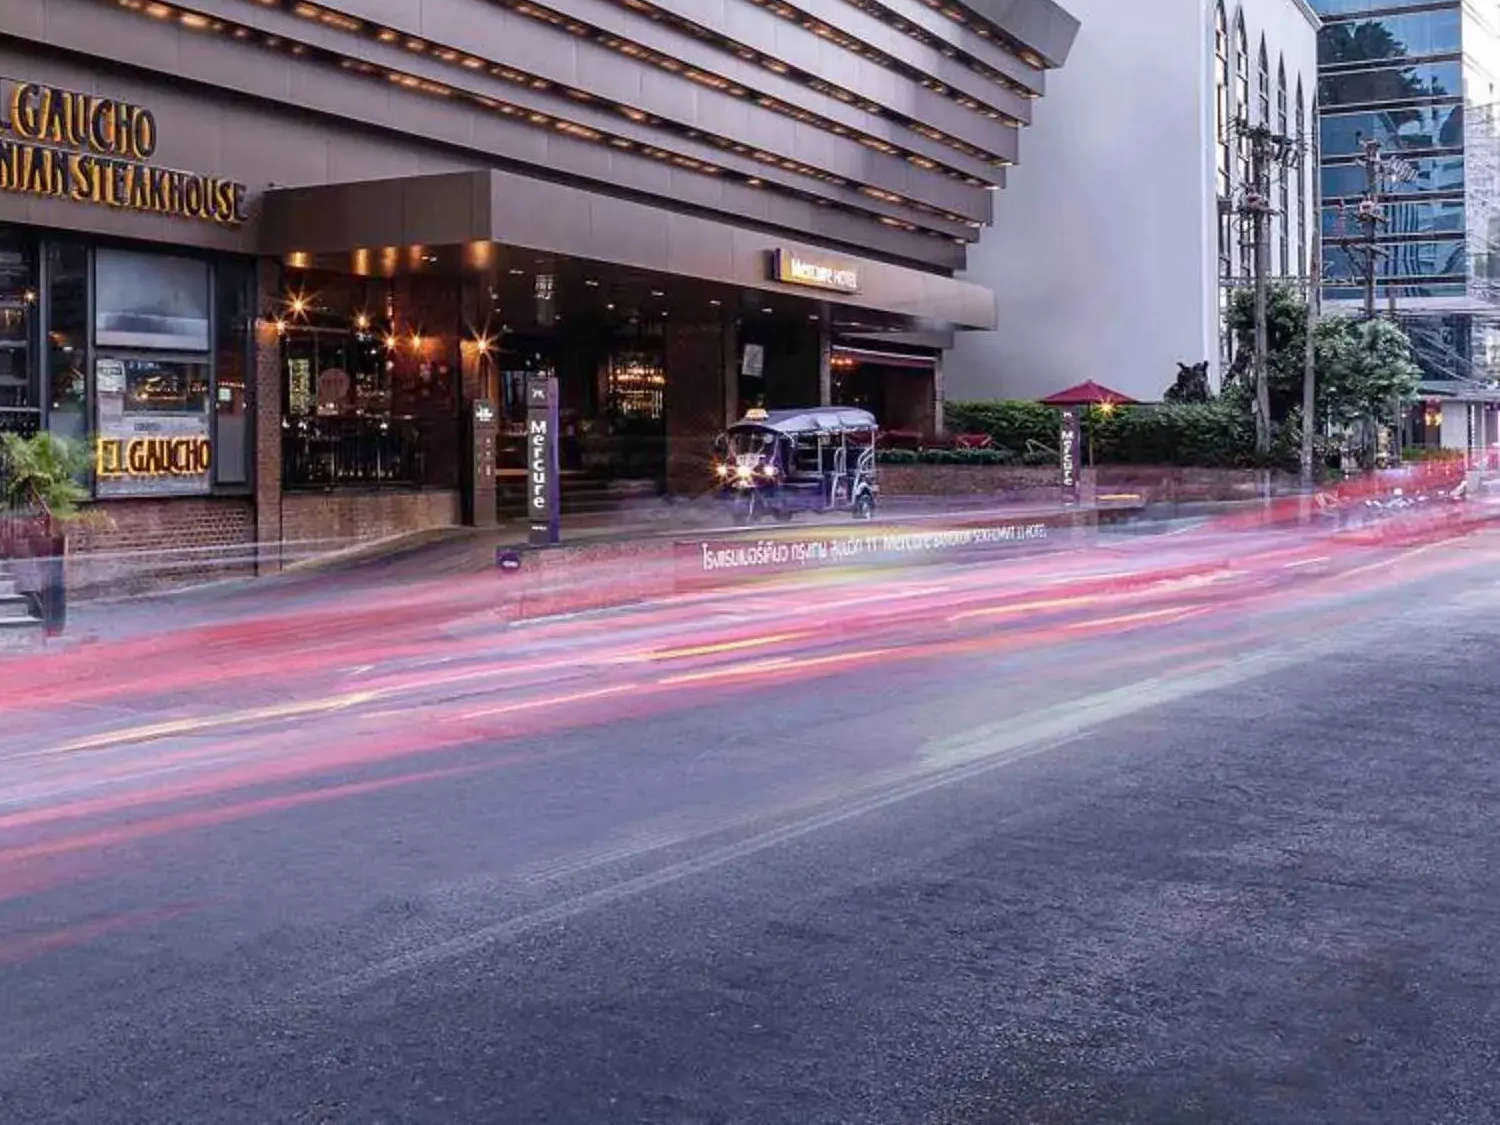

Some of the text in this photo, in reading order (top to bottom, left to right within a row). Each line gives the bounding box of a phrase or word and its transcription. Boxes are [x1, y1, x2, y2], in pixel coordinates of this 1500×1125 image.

[10, 81, 157, 160] GAUCHO
[70, 153, 250, 226] STEAKHOUSE
[97, 437, 213, 476] EL GAUCHO
[530, 420, 547, 508] Mercure
[1061, 430, 1074, 486] Mercure
